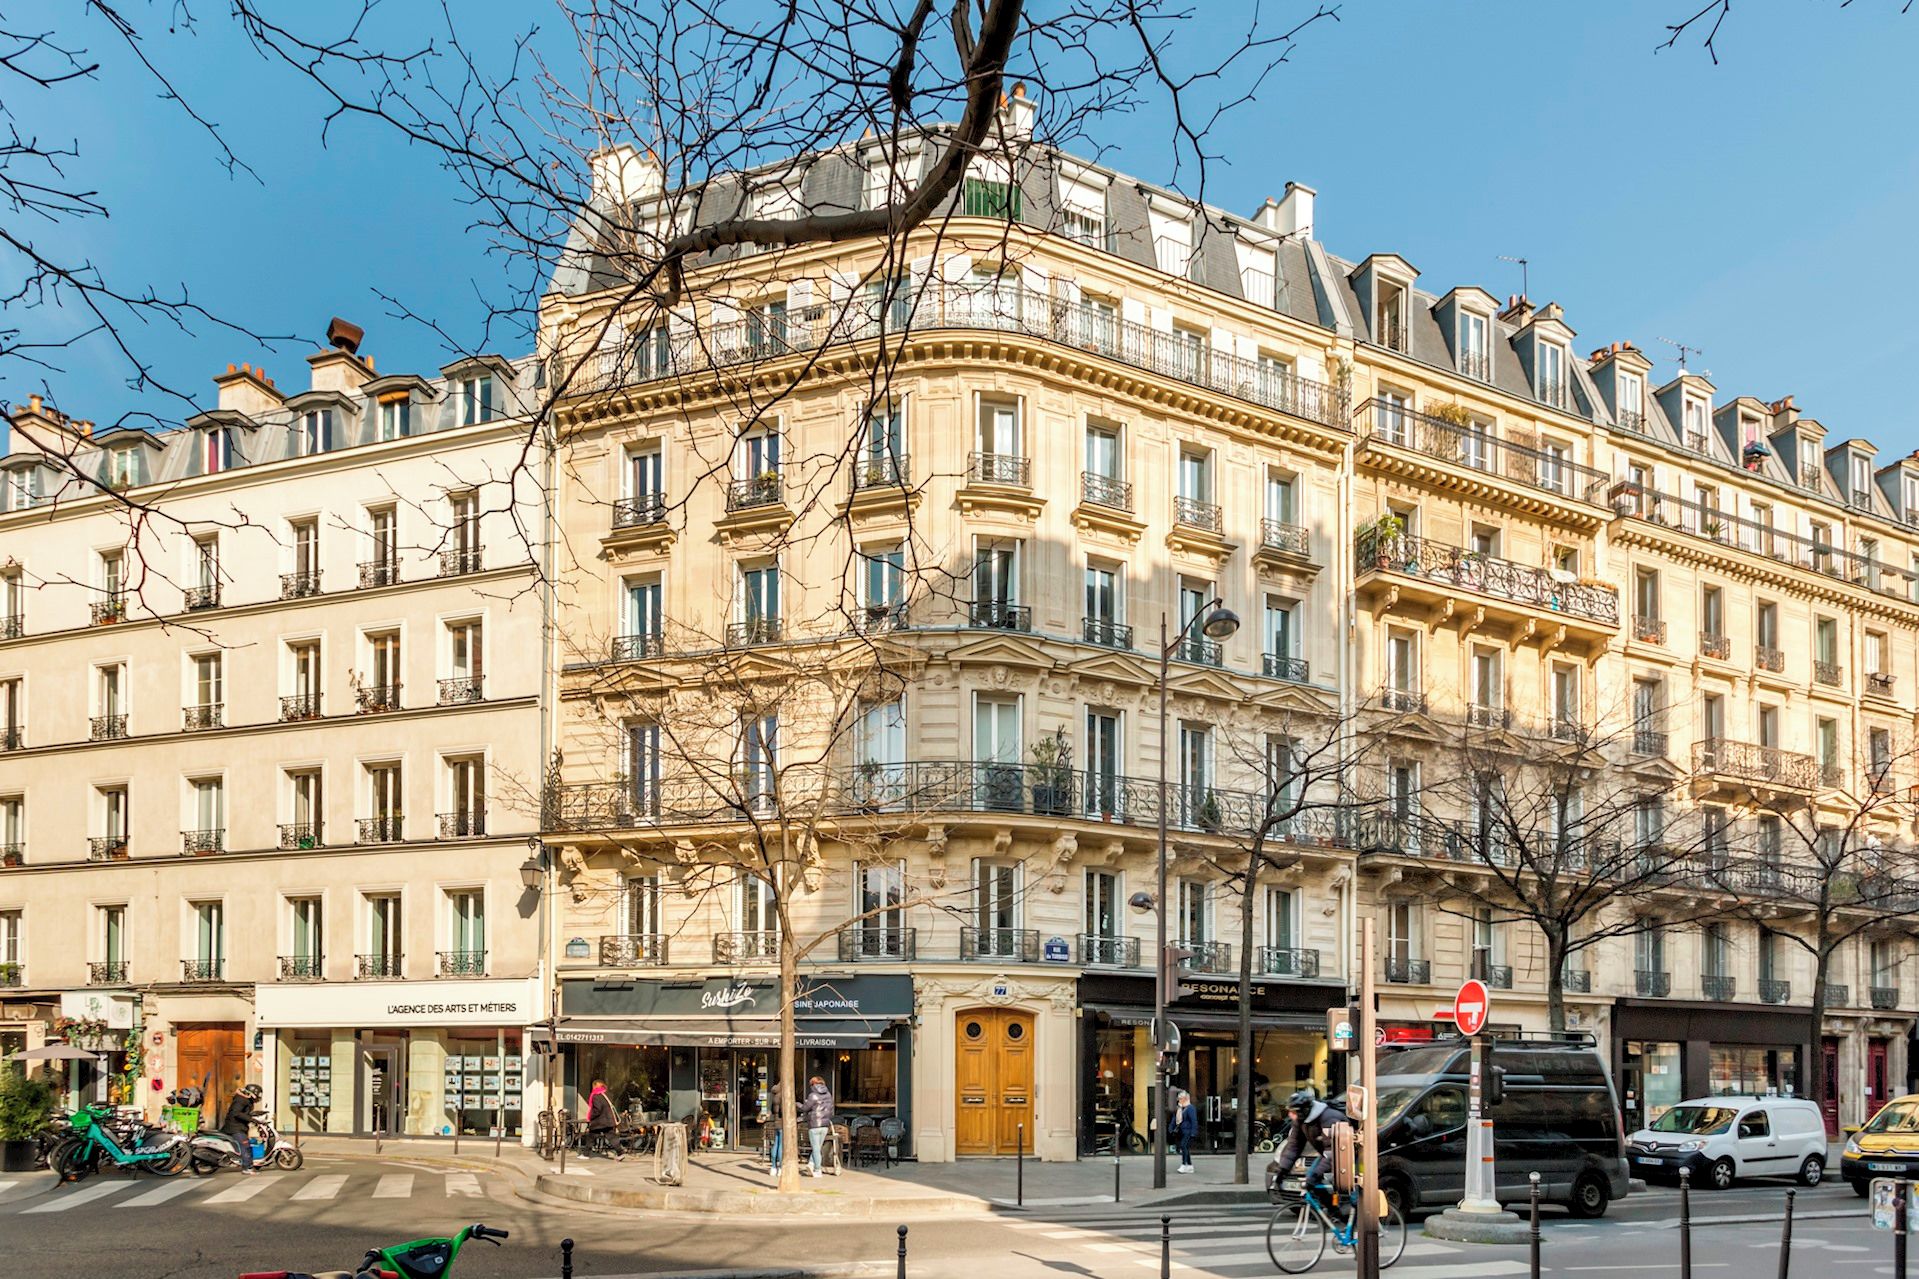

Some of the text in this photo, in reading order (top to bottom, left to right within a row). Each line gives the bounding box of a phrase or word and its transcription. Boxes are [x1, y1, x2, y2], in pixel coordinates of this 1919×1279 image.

[995, 986, 1006, 995] 77
[1182, 984, 1265, 995] RESONACE
[387, 1001, 517, 1014] L'AGENCE DES ARTS ET MÉTIERS
[814, 1000, 859, 1008] JAPONAISE
[714, 1037, 750, 1046] EMPORTER
[755, 1038, 769, 1046] SUR
